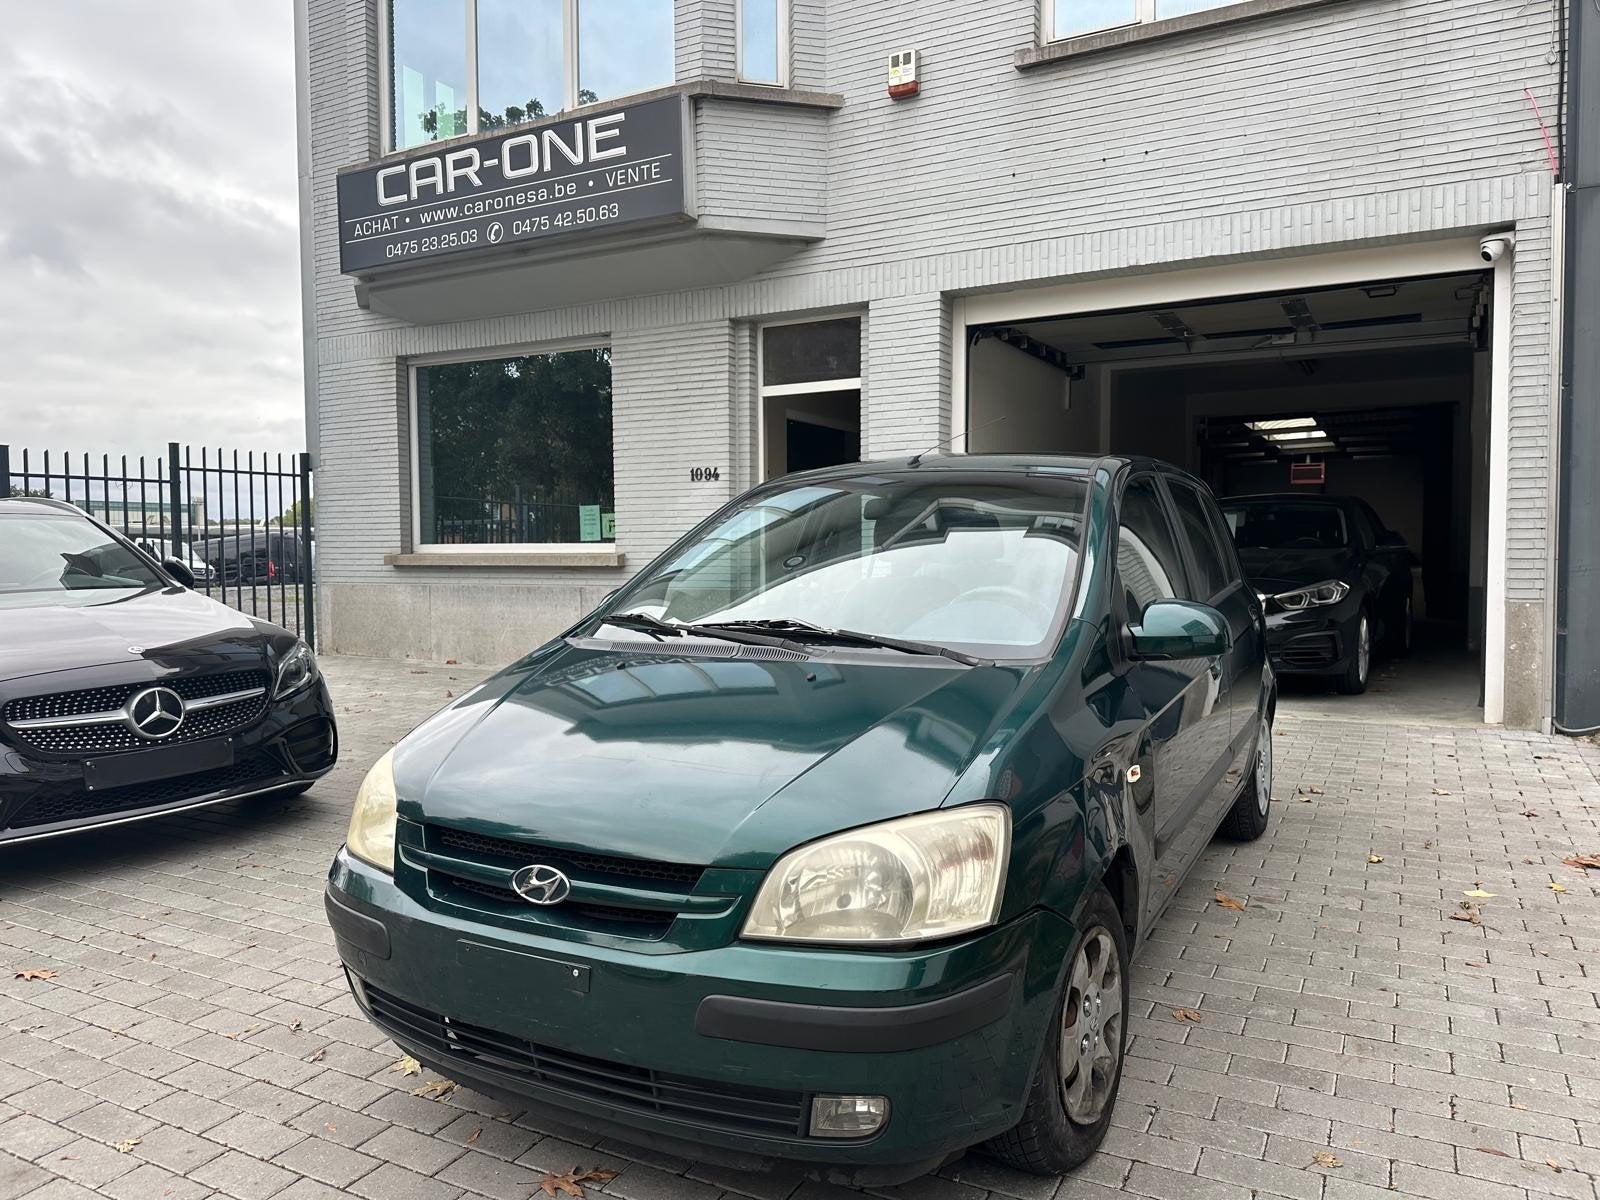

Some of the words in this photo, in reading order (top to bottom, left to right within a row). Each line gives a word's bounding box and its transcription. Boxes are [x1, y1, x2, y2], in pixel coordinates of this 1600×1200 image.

[377, 112, 626, 207] CAR-ONE
[354, 216, 399, 237] ACHAT
[420, 182, 577, 224] www.caronesa.be
[605, 162, 661, 187] VENTE
[386, 240, 418, 258] 0475
[421, 229, 478, 251] 23.25.03
[513, 216, 550, 235] 0475
[554, 203, 619, 227] 42.50.63
[690, 467, 720, 481] 1094
